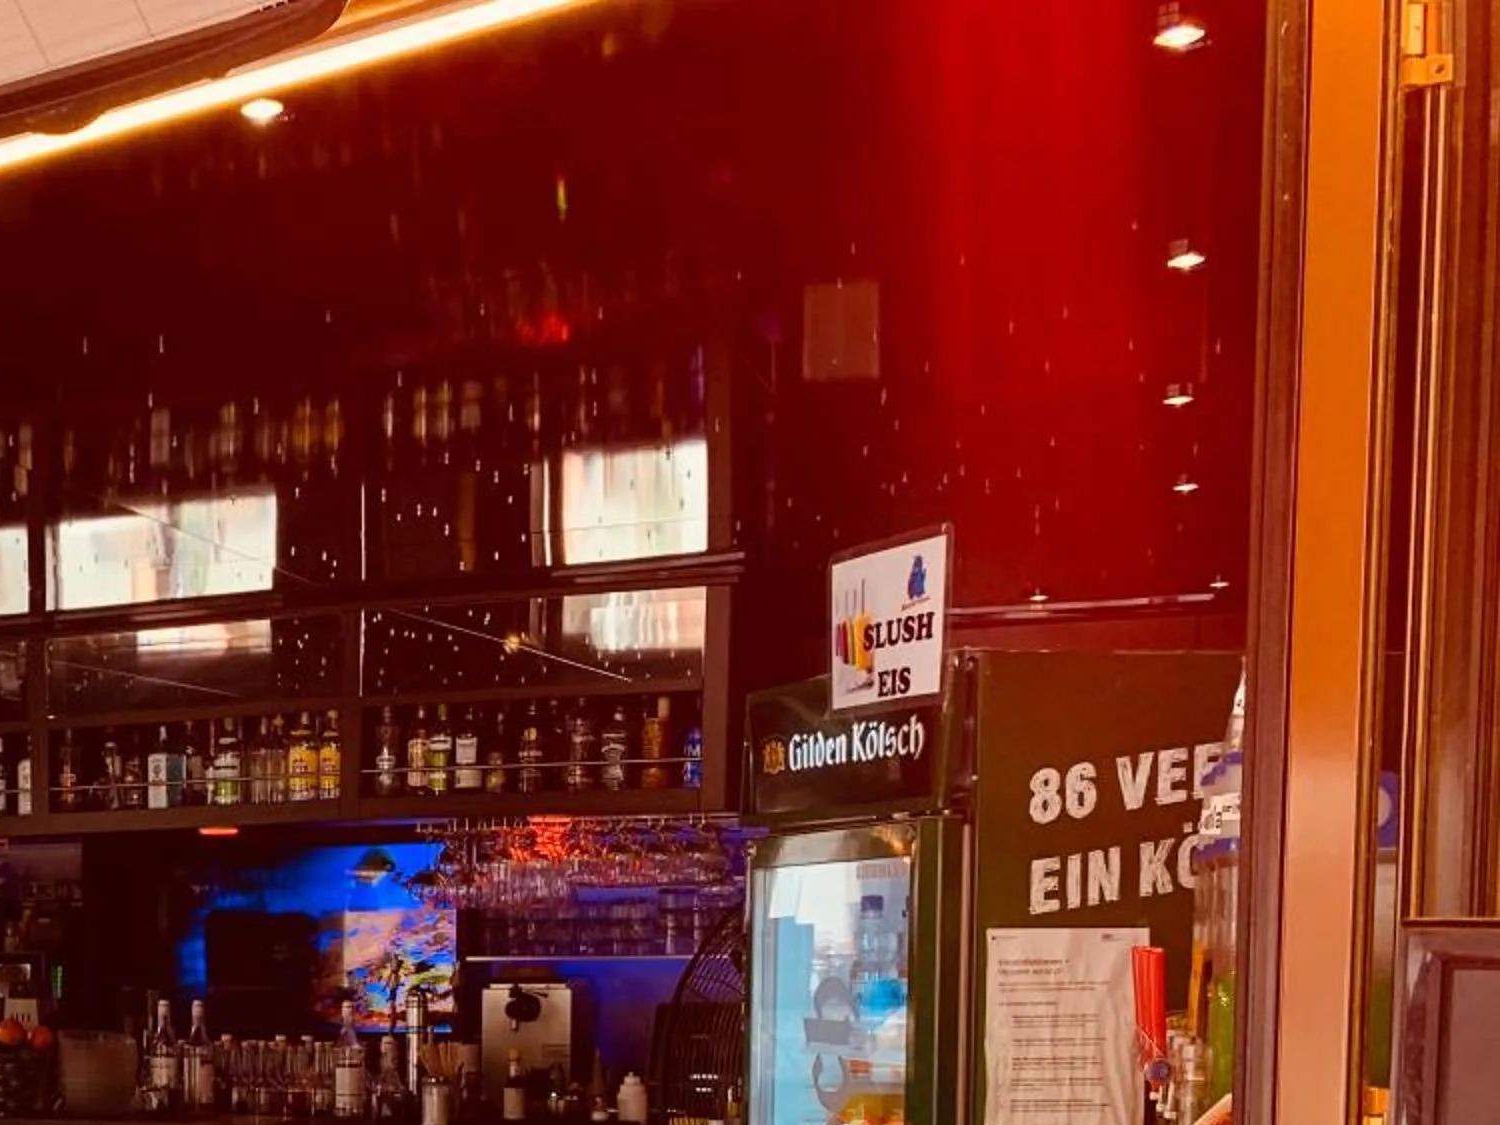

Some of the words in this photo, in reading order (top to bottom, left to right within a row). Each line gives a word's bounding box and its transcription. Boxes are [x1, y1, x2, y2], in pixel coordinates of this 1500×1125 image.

[863, 612, 935, 652] SLUSH
[877, 667, 911, 697] EIS
[788, 731, 847, 773] Gilden
[851, 714, 926, 764] Kölsch
[1028, 761, 1098, 825] 86
[1028, 846, 1122, 916] EIN
